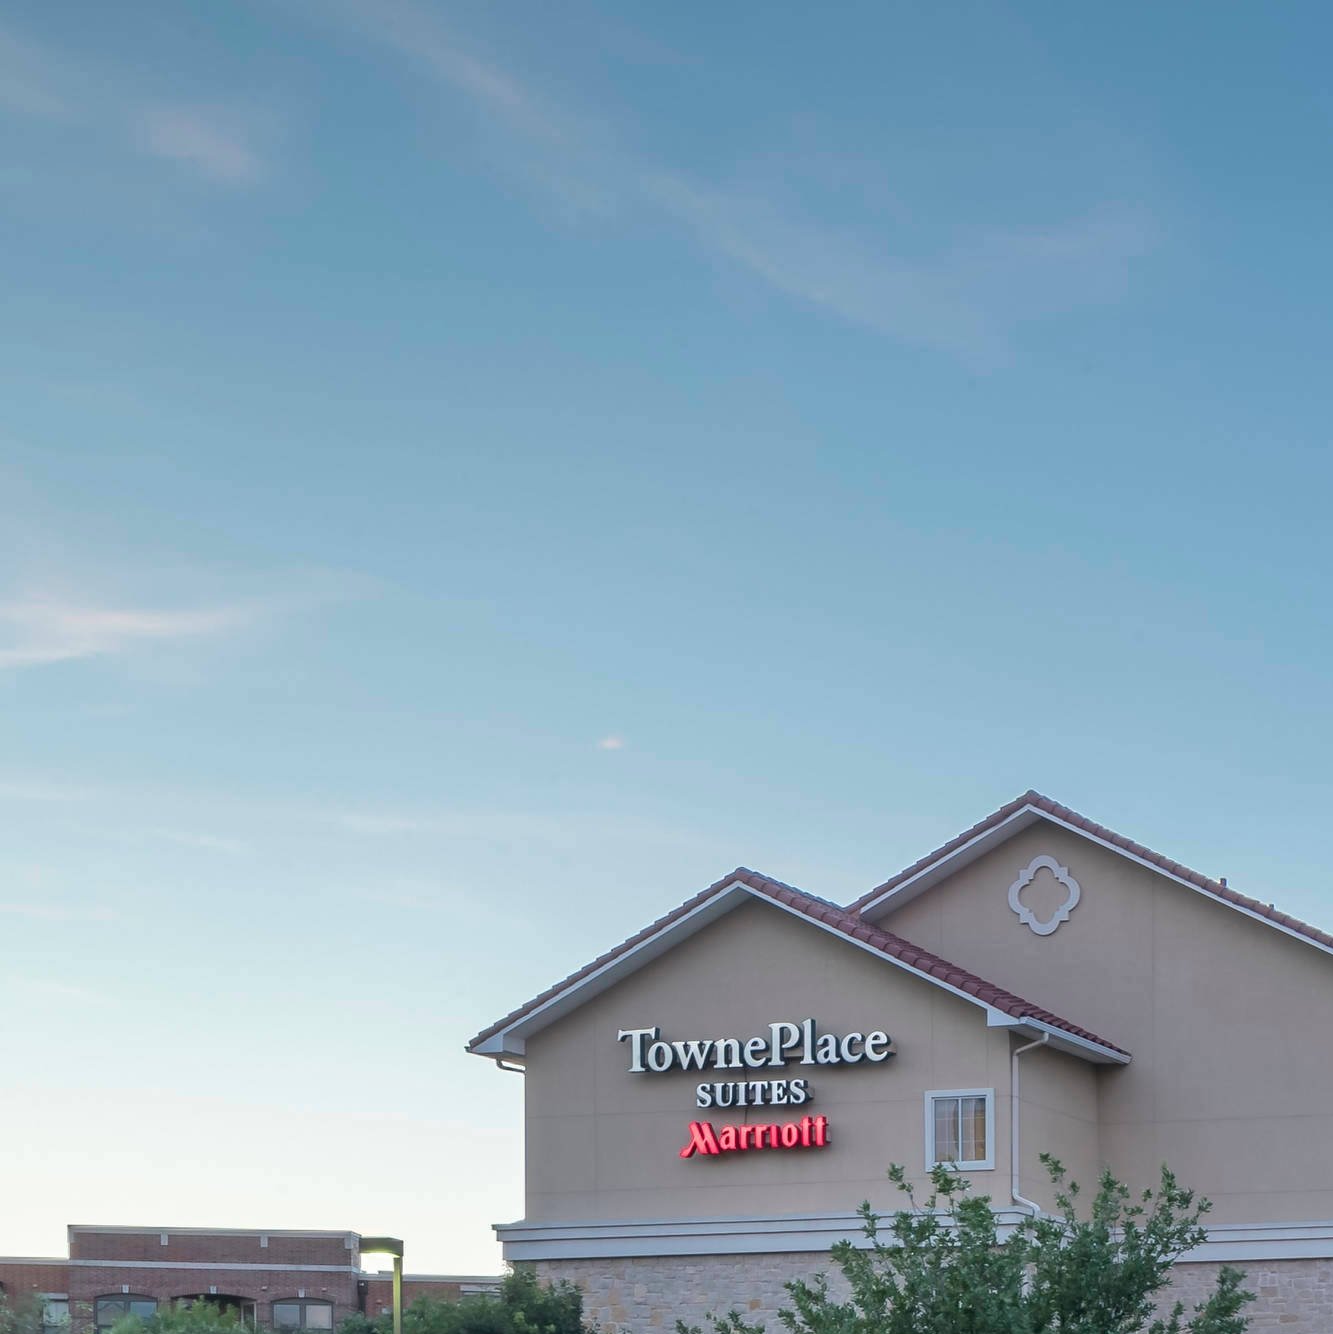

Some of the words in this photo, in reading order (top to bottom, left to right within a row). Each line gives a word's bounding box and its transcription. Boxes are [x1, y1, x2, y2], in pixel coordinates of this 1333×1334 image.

[617, 1018, 892, 1073] TownePlace
[696, 1079, 809, 1108] SUITES
[680, 1116, 829, 1158] Marriott
